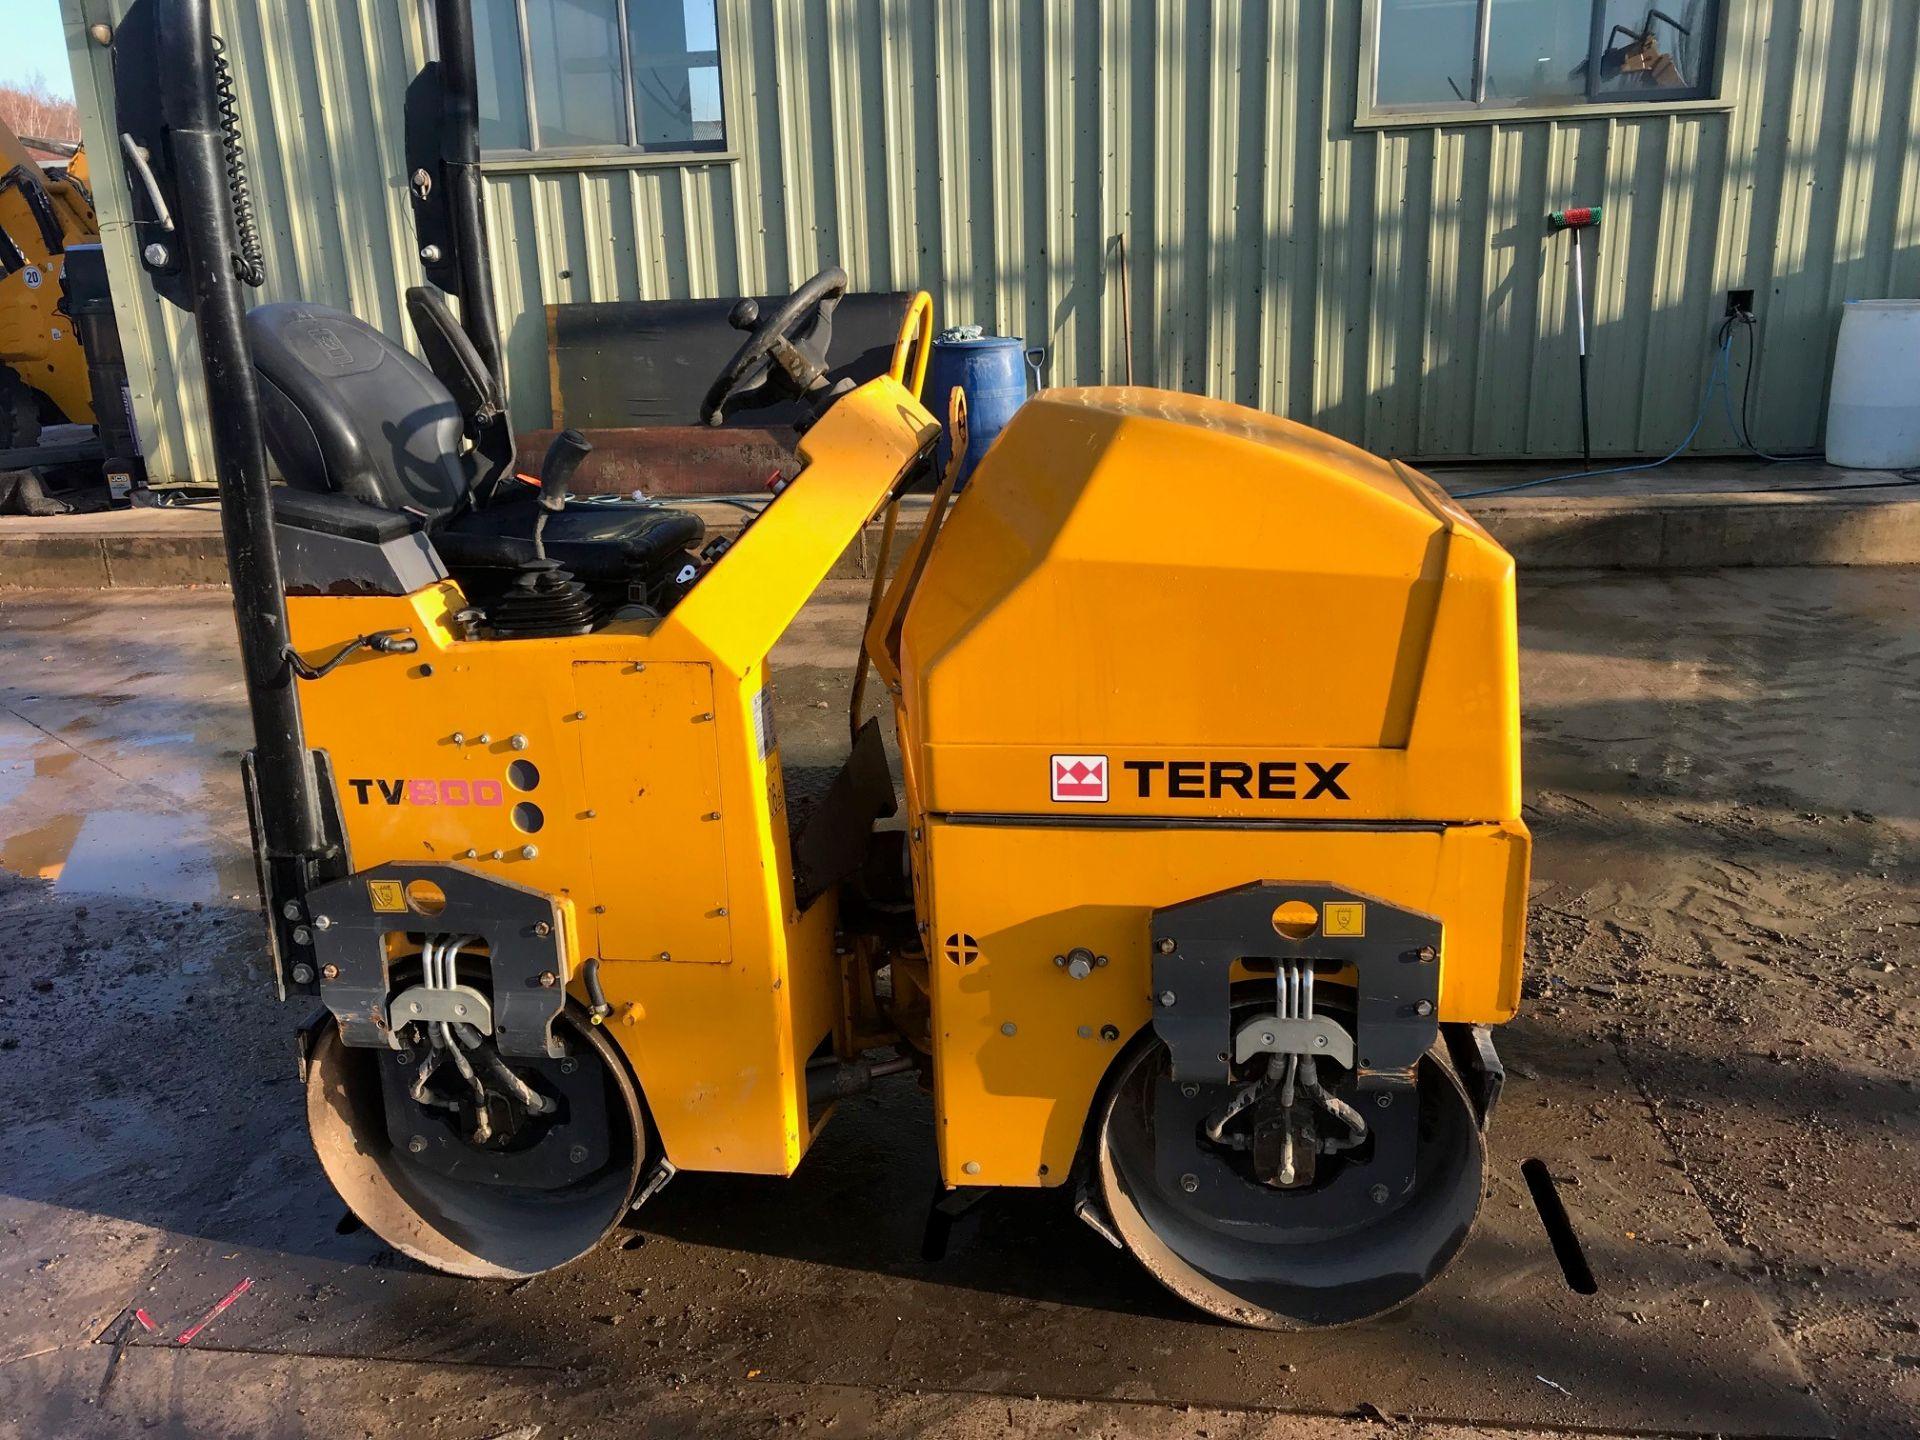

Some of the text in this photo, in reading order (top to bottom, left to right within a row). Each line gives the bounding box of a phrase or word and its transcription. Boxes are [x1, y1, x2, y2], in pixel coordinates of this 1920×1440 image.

[26, 271, 39, 284] 20
[348, 778, 503, 807] TV800
[1123, 760, 1351, 800] TEREX
